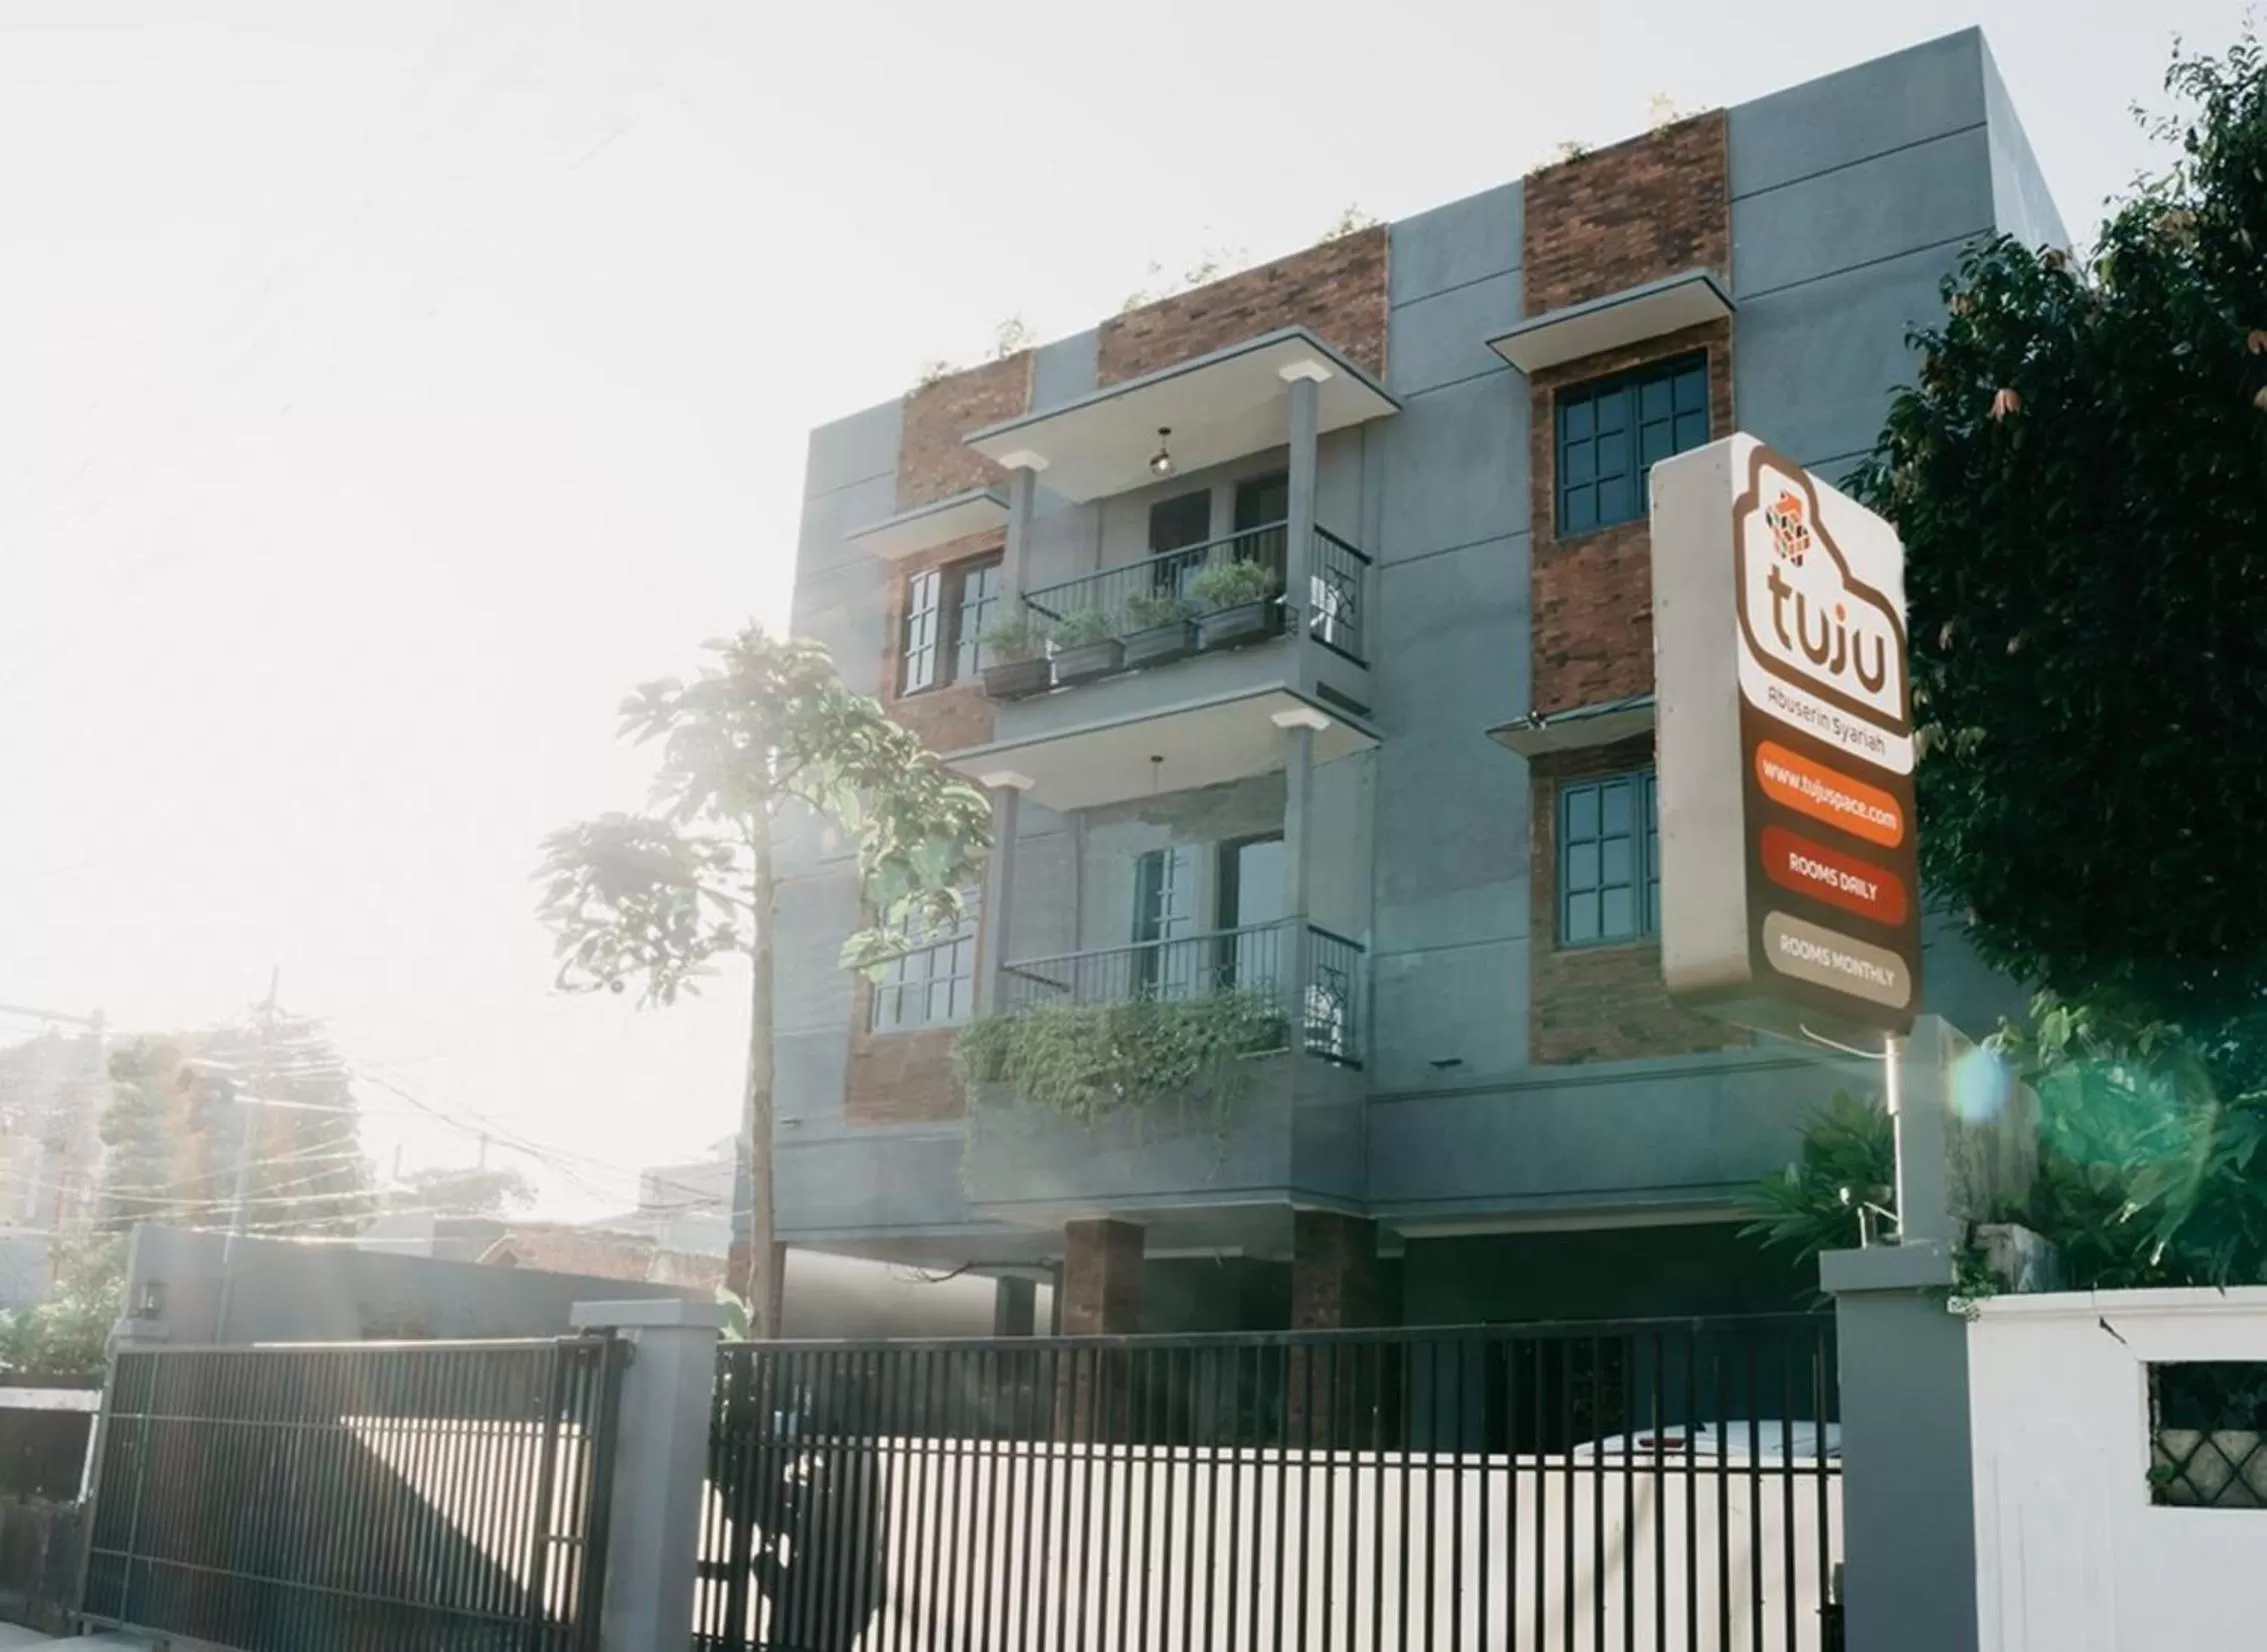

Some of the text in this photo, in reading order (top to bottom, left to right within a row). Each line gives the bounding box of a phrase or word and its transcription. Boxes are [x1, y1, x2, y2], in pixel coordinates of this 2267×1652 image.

[1767, 563, 1885, 694] tuju
[1768, 685, 1886, 757] Abuserin Syariah
[1762, 758, 1897, 831] www.tujuspace.com
[1788, 851, 1878, 901] ROOMS DAILY
[1780, 933, 1895, 987] ROOMS MONTHLY
